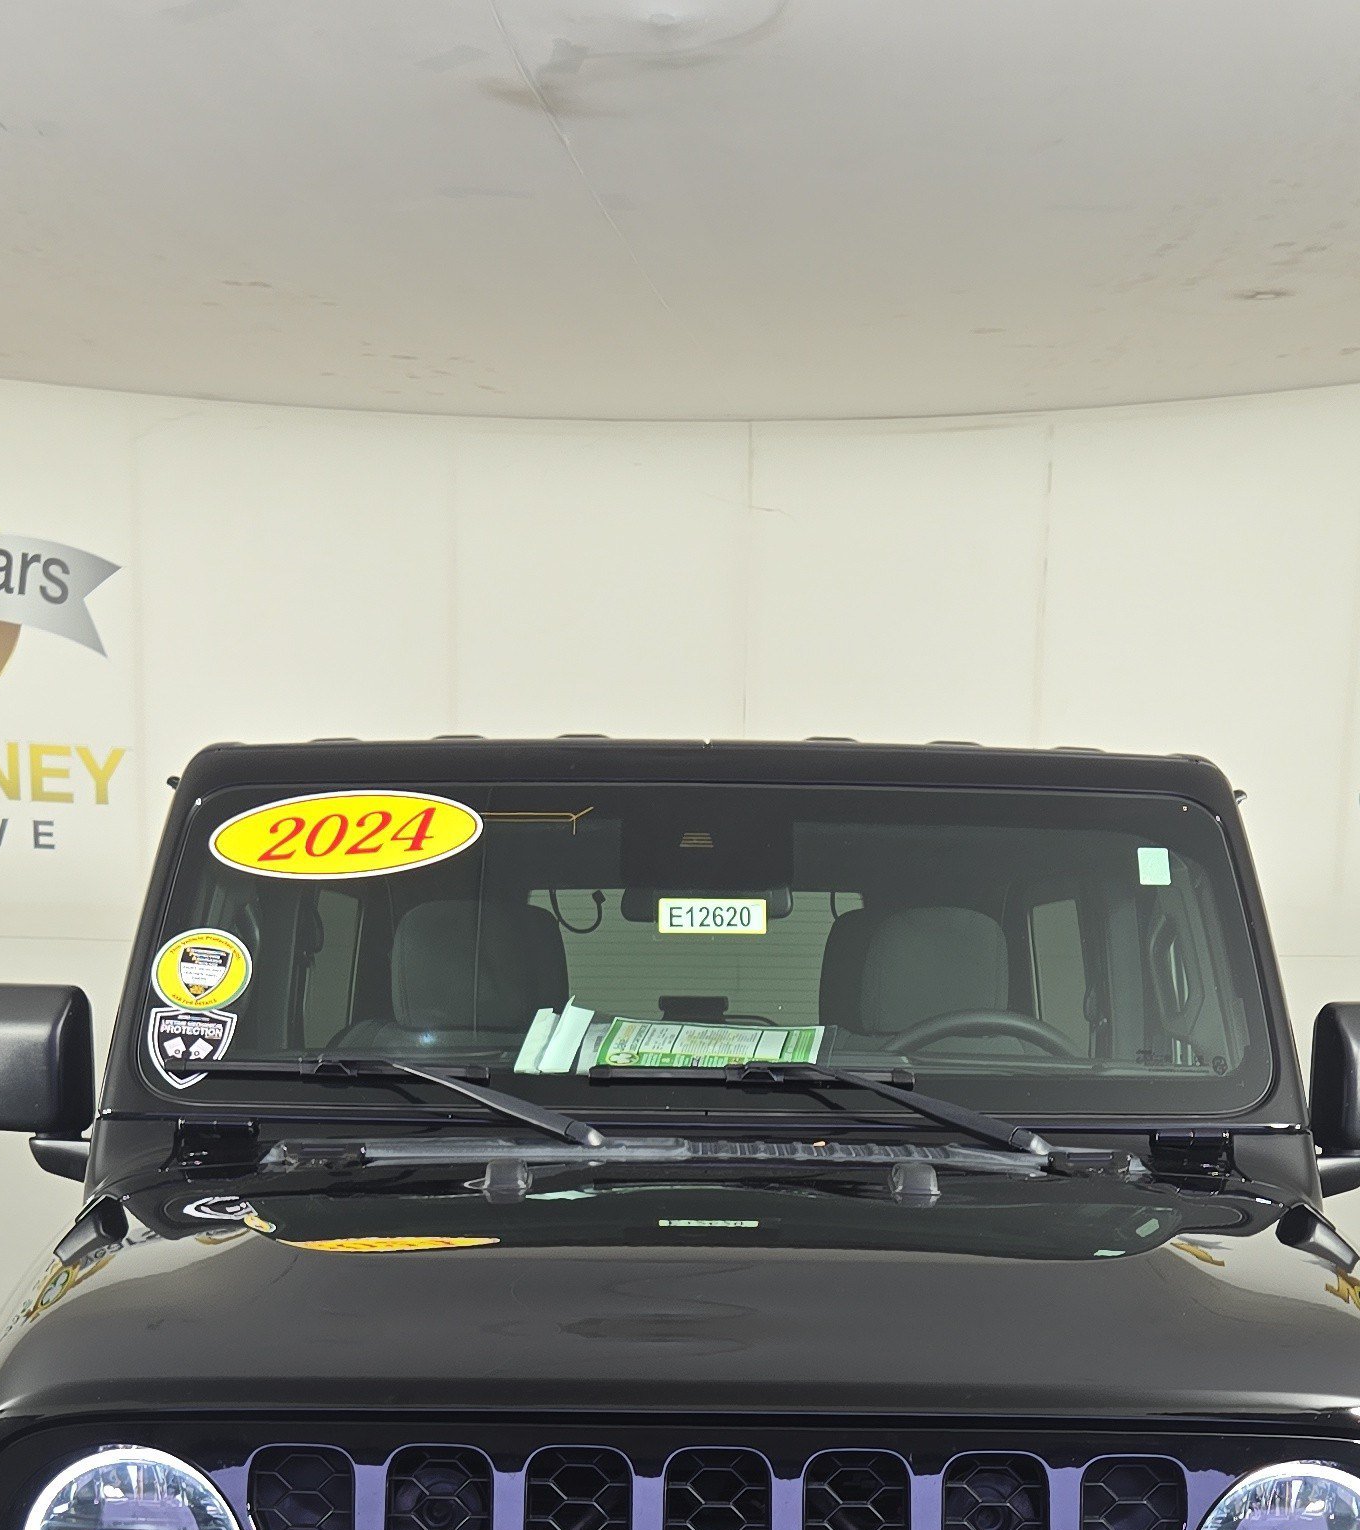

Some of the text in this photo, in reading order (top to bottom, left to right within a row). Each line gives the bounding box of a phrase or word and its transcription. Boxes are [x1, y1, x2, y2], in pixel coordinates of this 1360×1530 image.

[257, 806, 437, 862] 2024
[669, 905, 751, 928] E12620
[160, 1025, 223, 1037] PROTECTION
